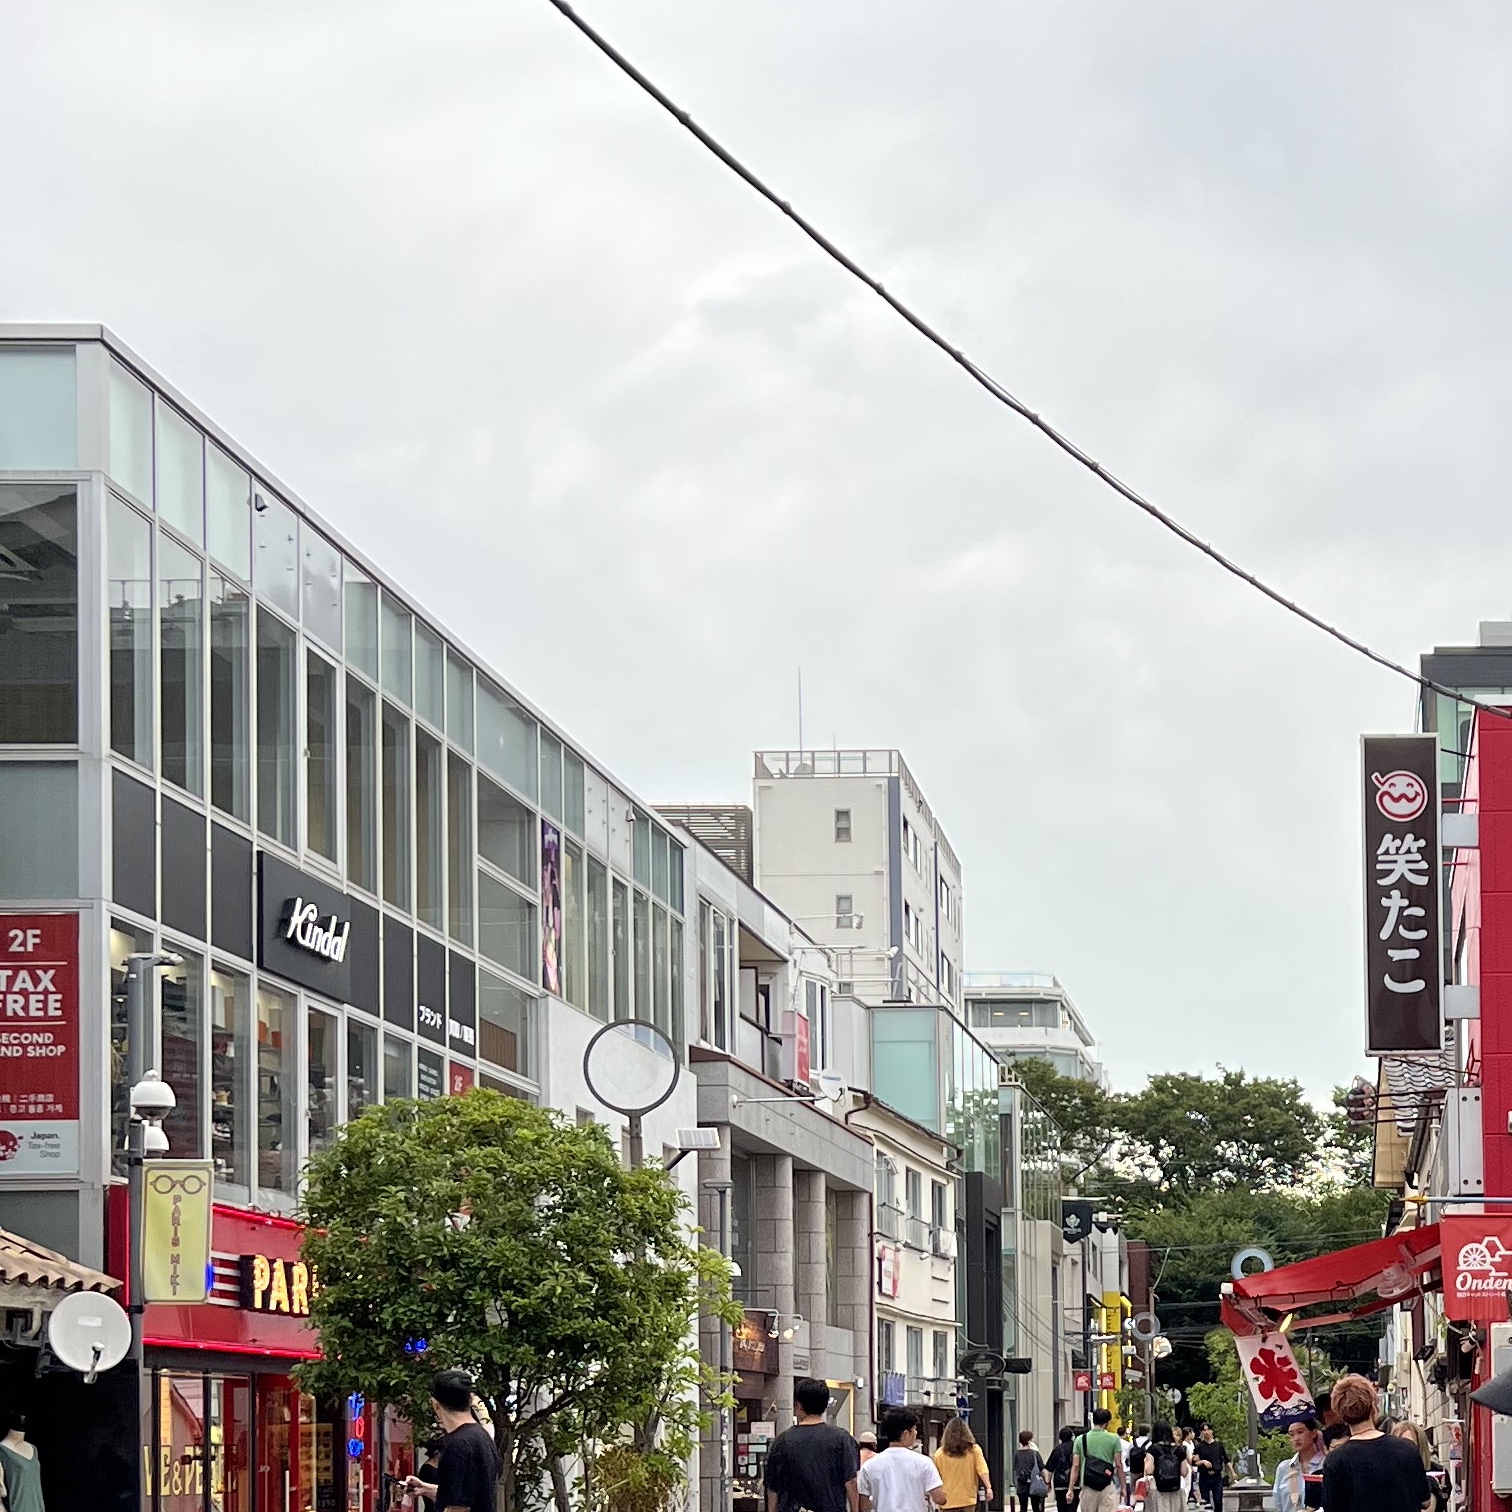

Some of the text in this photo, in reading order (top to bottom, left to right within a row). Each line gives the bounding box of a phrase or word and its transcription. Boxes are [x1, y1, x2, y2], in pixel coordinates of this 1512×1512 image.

[1375, 833, 1430, 994] 笑たこ
[8, 928, 42, 953] 2F
[286, 896, 350, 963] Kindal
[0, 969, 57, 993] TAX
[0, 993, 64, 1017] REE
[0, 1032, 54, 1044] ECOND
[26, 1044, 67, 1057] SHOP
[170, 1253, 181, 1296] MIKI
